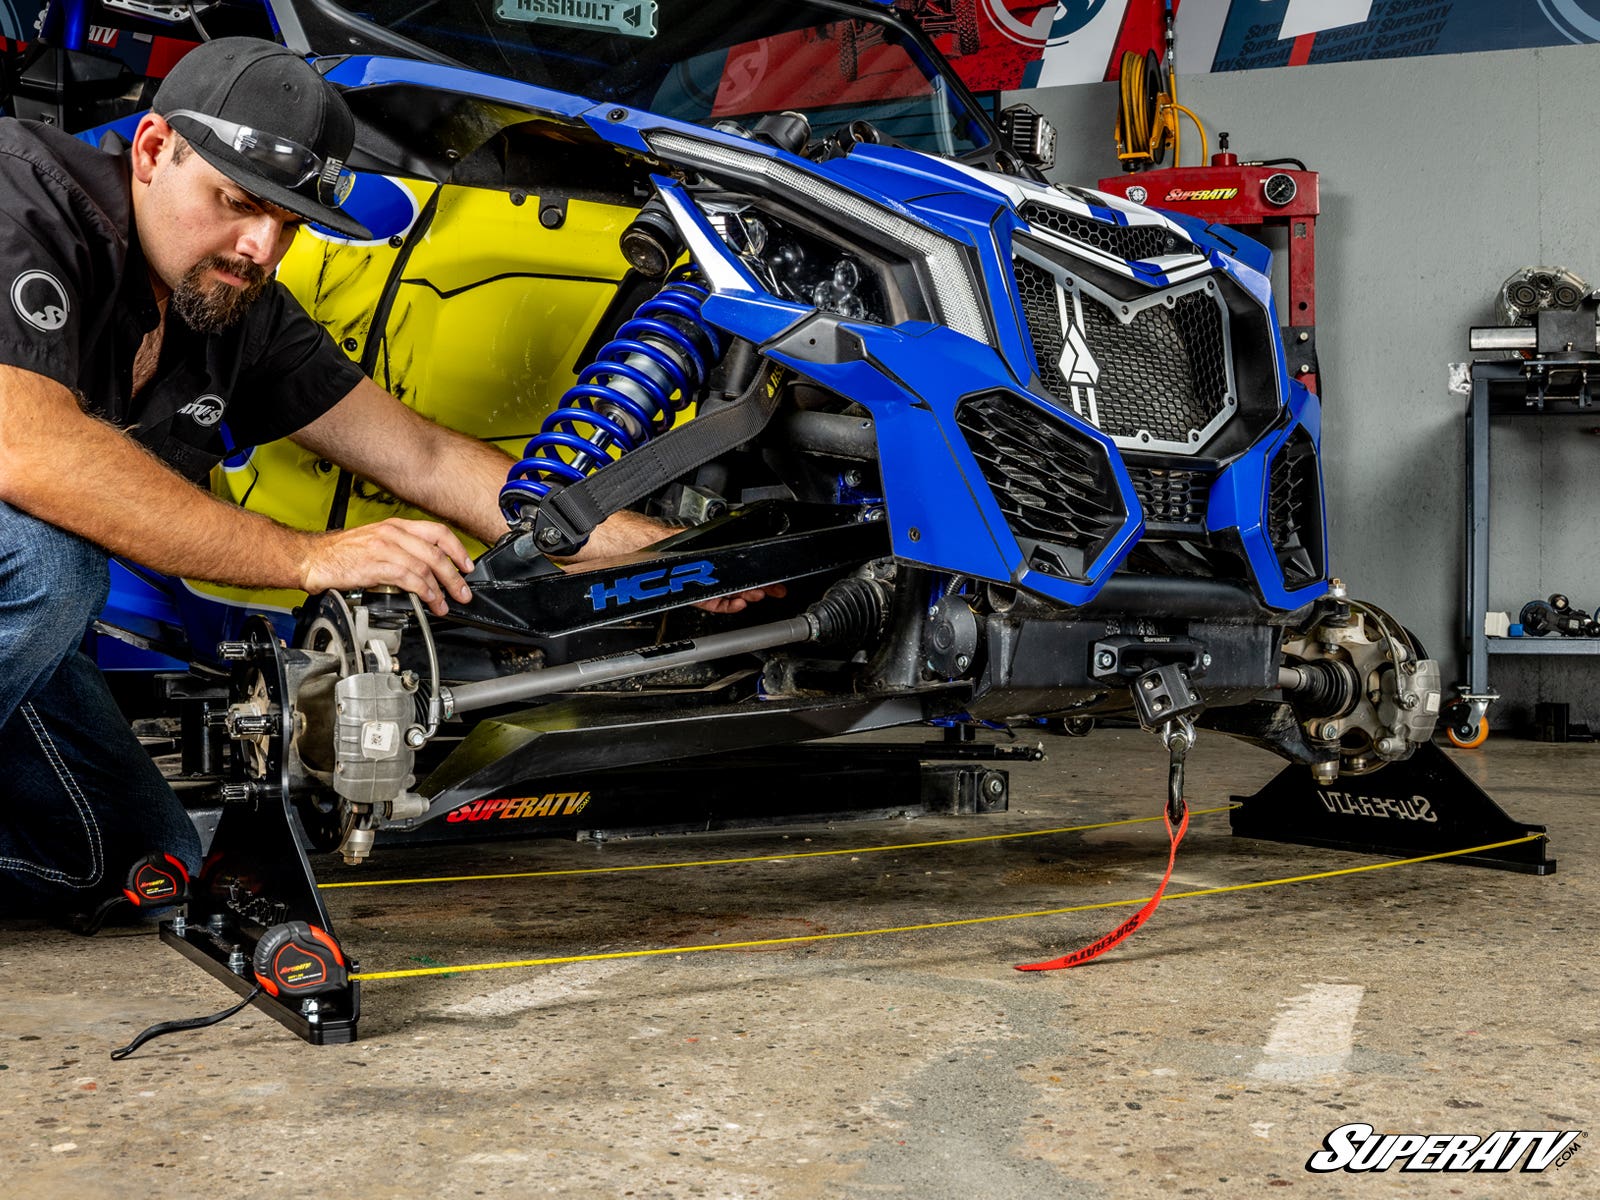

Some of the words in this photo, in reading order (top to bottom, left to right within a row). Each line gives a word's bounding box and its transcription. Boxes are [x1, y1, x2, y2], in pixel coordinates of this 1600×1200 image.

[1378, 3, 1454, 34] SUPERATV
[1372, 20, 1448, 50] SUPERATV
[1165, 188, 1238, 202] SUPERATV
[589, 560, 720, 611] HCR
[447, 791, 590, 823] SUPERATV
